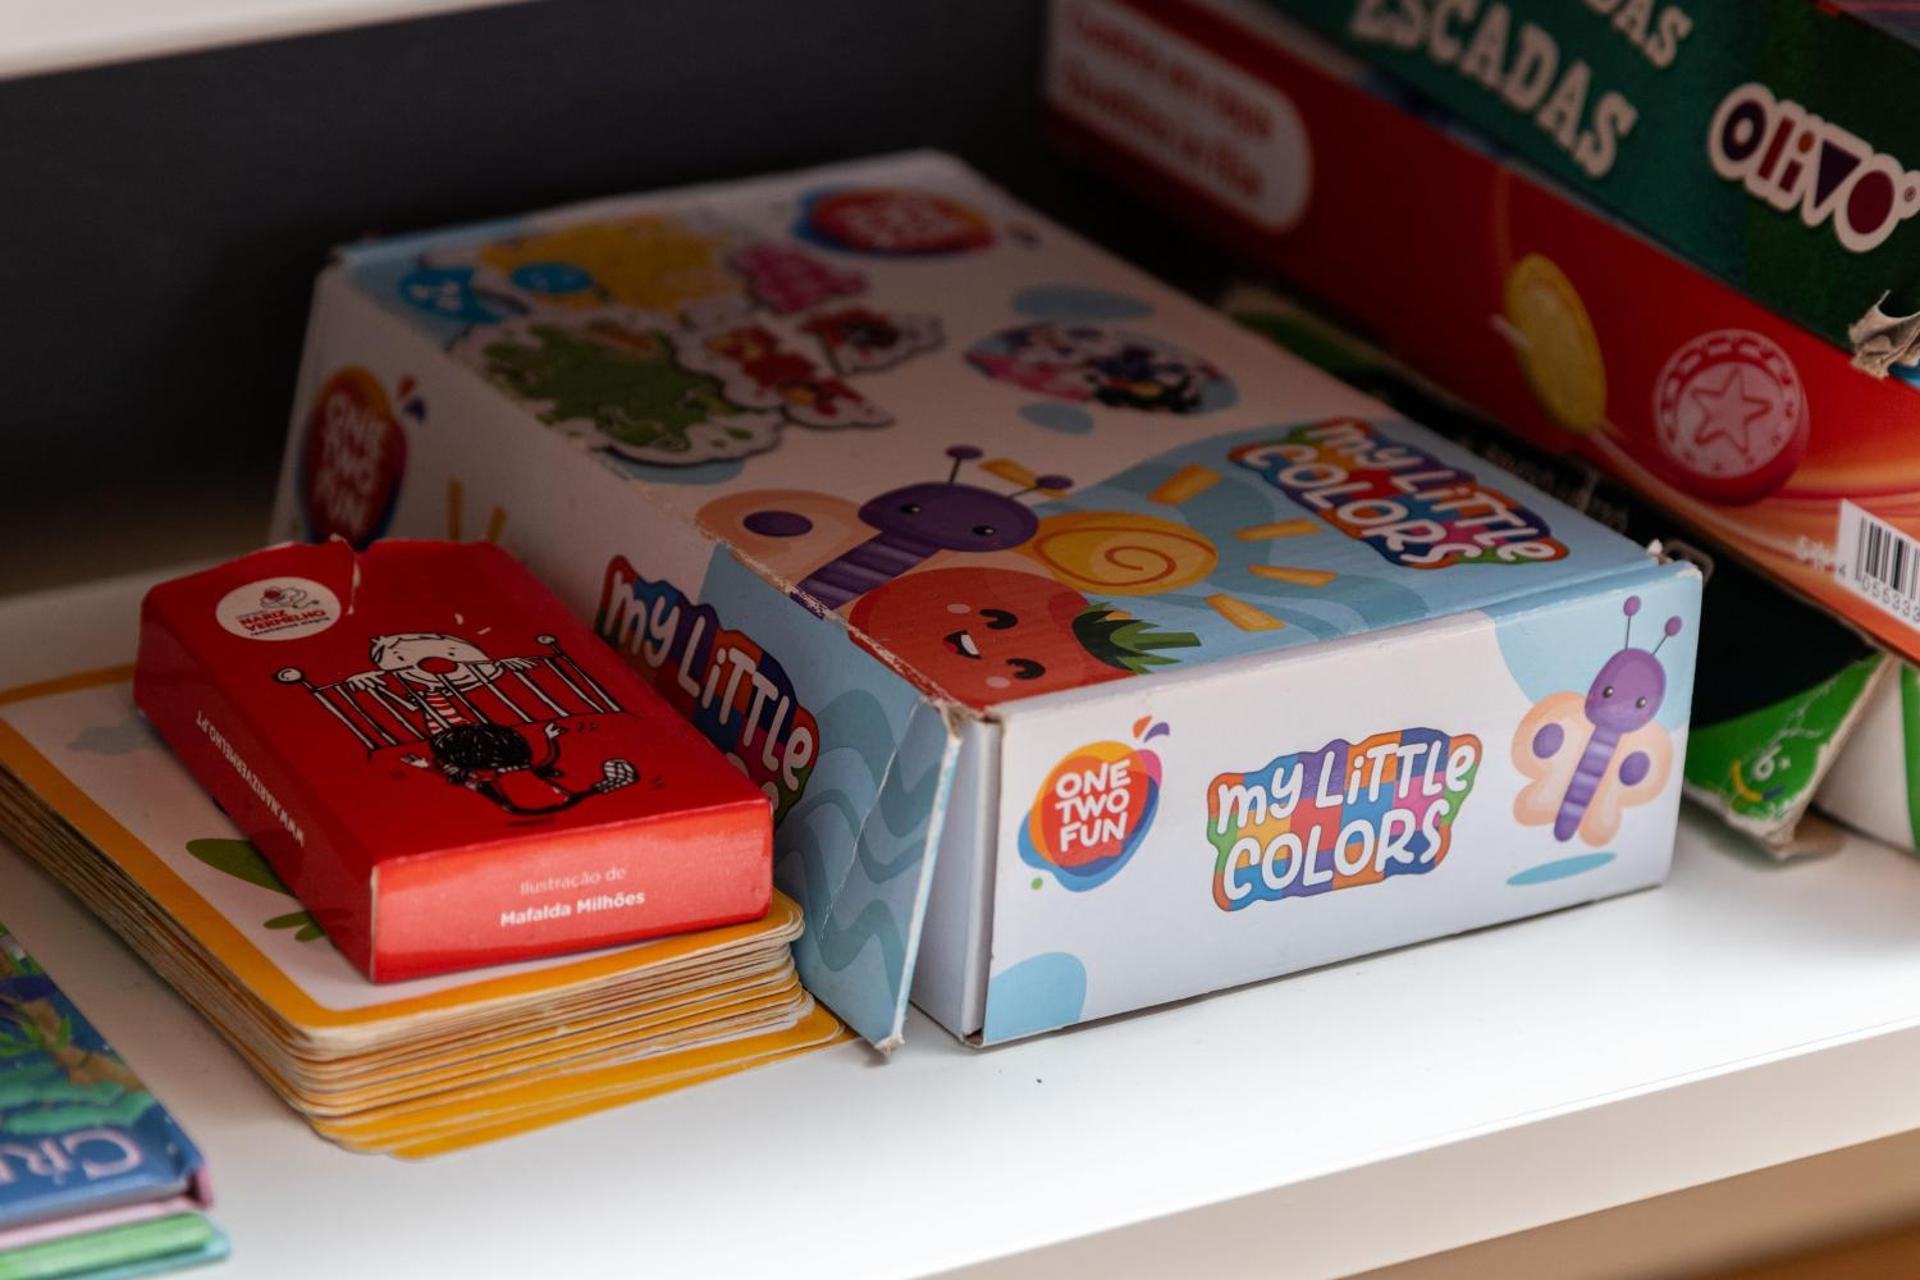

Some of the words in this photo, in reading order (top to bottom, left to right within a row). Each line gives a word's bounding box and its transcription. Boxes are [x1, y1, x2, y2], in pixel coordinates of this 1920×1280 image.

[1584, 0, 1693, 67] AS
[1242, 443, 1483, 564] COLORS
[1055, 758, 1132, 801] ONE
[1054, 787, 1131, 825] TWO
[1059, 811, 1129, 853] FUN
[1222, 798, 1451, 902] COLORS
[519, 871, 602, 896] Ilustração
[604, 865, 628, 882] de
[499, 903, 573, 928] Mafalda
[575, 891, 647, 915] Milhões
